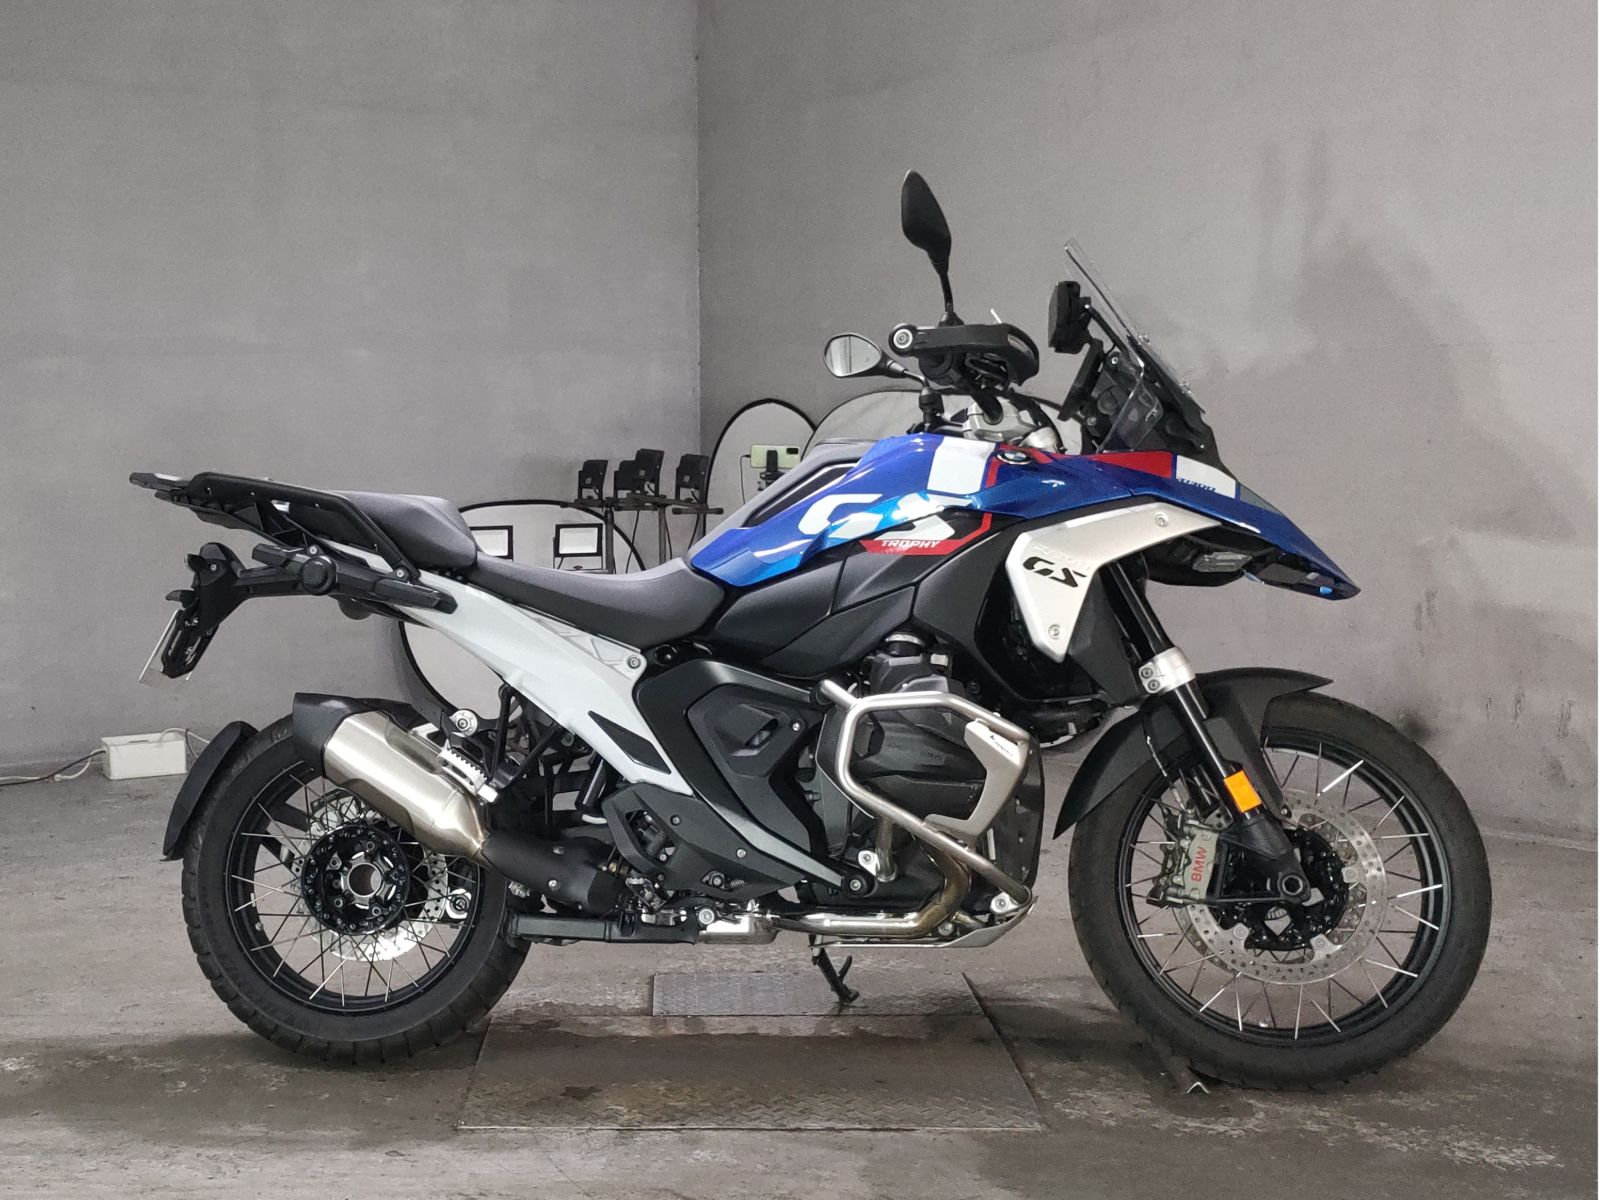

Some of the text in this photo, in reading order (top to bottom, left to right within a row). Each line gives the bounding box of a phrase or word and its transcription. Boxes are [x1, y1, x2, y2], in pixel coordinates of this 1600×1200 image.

[798, 492, 973, 540] GS
[881, 540, 941, 549] TROPHY
[1023, 556, 1088, 588] GS
[1191, 846, 1208, 882] BMW
